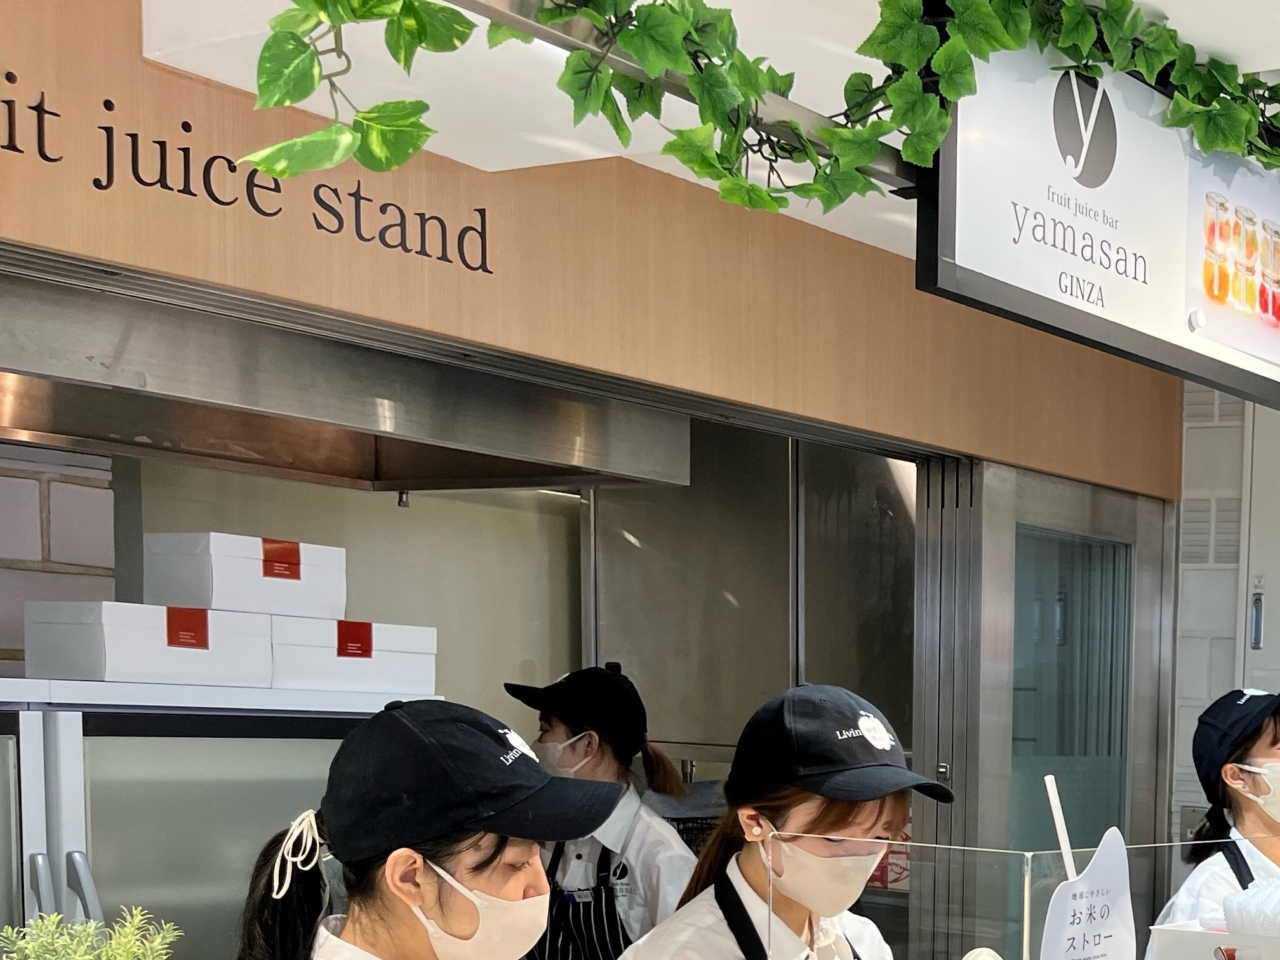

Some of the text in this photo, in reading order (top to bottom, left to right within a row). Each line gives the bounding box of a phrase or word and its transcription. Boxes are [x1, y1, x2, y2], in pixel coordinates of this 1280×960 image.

[93, 99, 283, 217] juice
[311, 179, 494, 275] stand
[1047, 185, 1119, 231] fruit juice bar
[1010, 201, 1148, 285] yamasan
[1058, 271, 1105, 308] GINZA
[1069, 903, 1110, 926] お米の
[1065, 933, 1113, 953] ストロー
